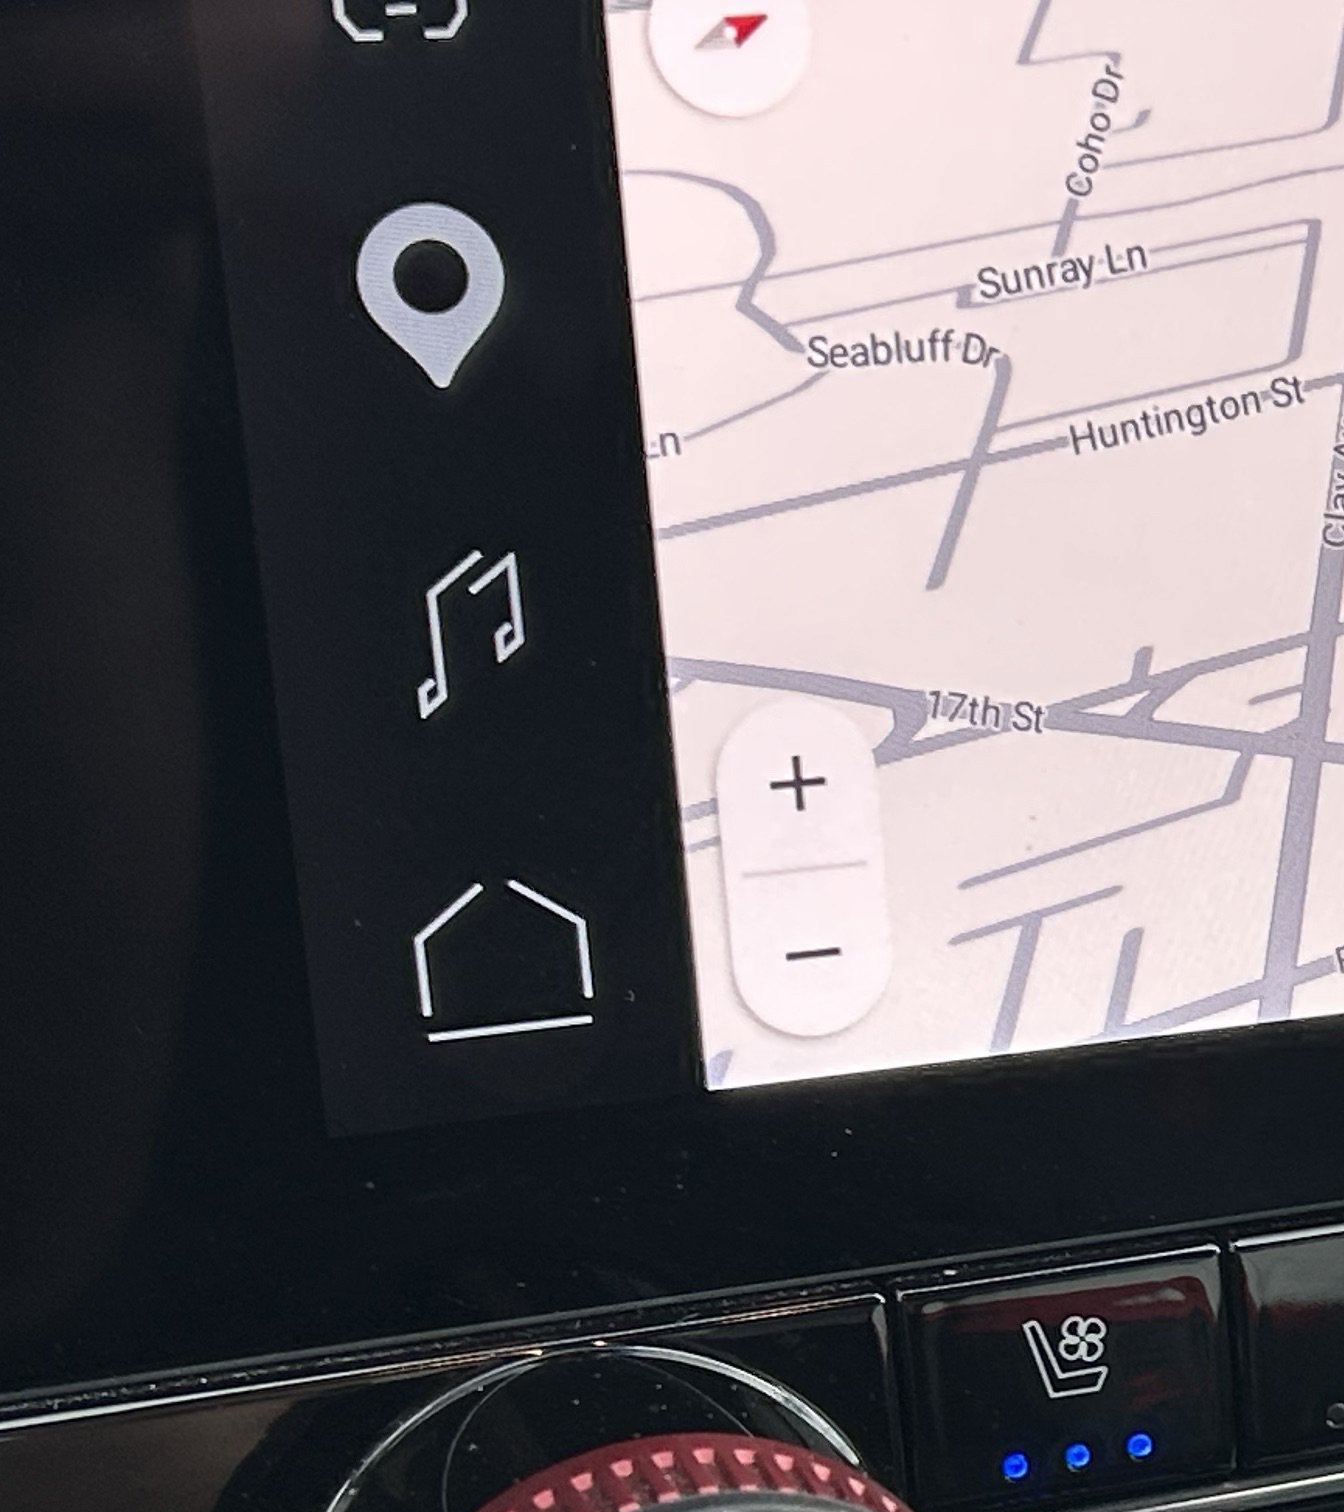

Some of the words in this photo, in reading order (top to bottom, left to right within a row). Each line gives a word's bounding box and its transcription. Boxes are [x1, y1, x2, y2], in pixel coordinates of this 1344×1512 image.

[1065, 112, 1110, 197] Coho
[1092, 65, 1123, 102] Dr
[977, 256, 1094, 299] Sunray
[1105, 244, 1148, 275] Ln
[807, 329, 954, 368] Seabluff
[962, 333, 999, 366] Dr
[1069, 391, 1262, 455] Huntington
[1270, 377, 1305, 408] St
[929, 690, 1001, 728] 17th
[1012, 701, 1044, 733] St
